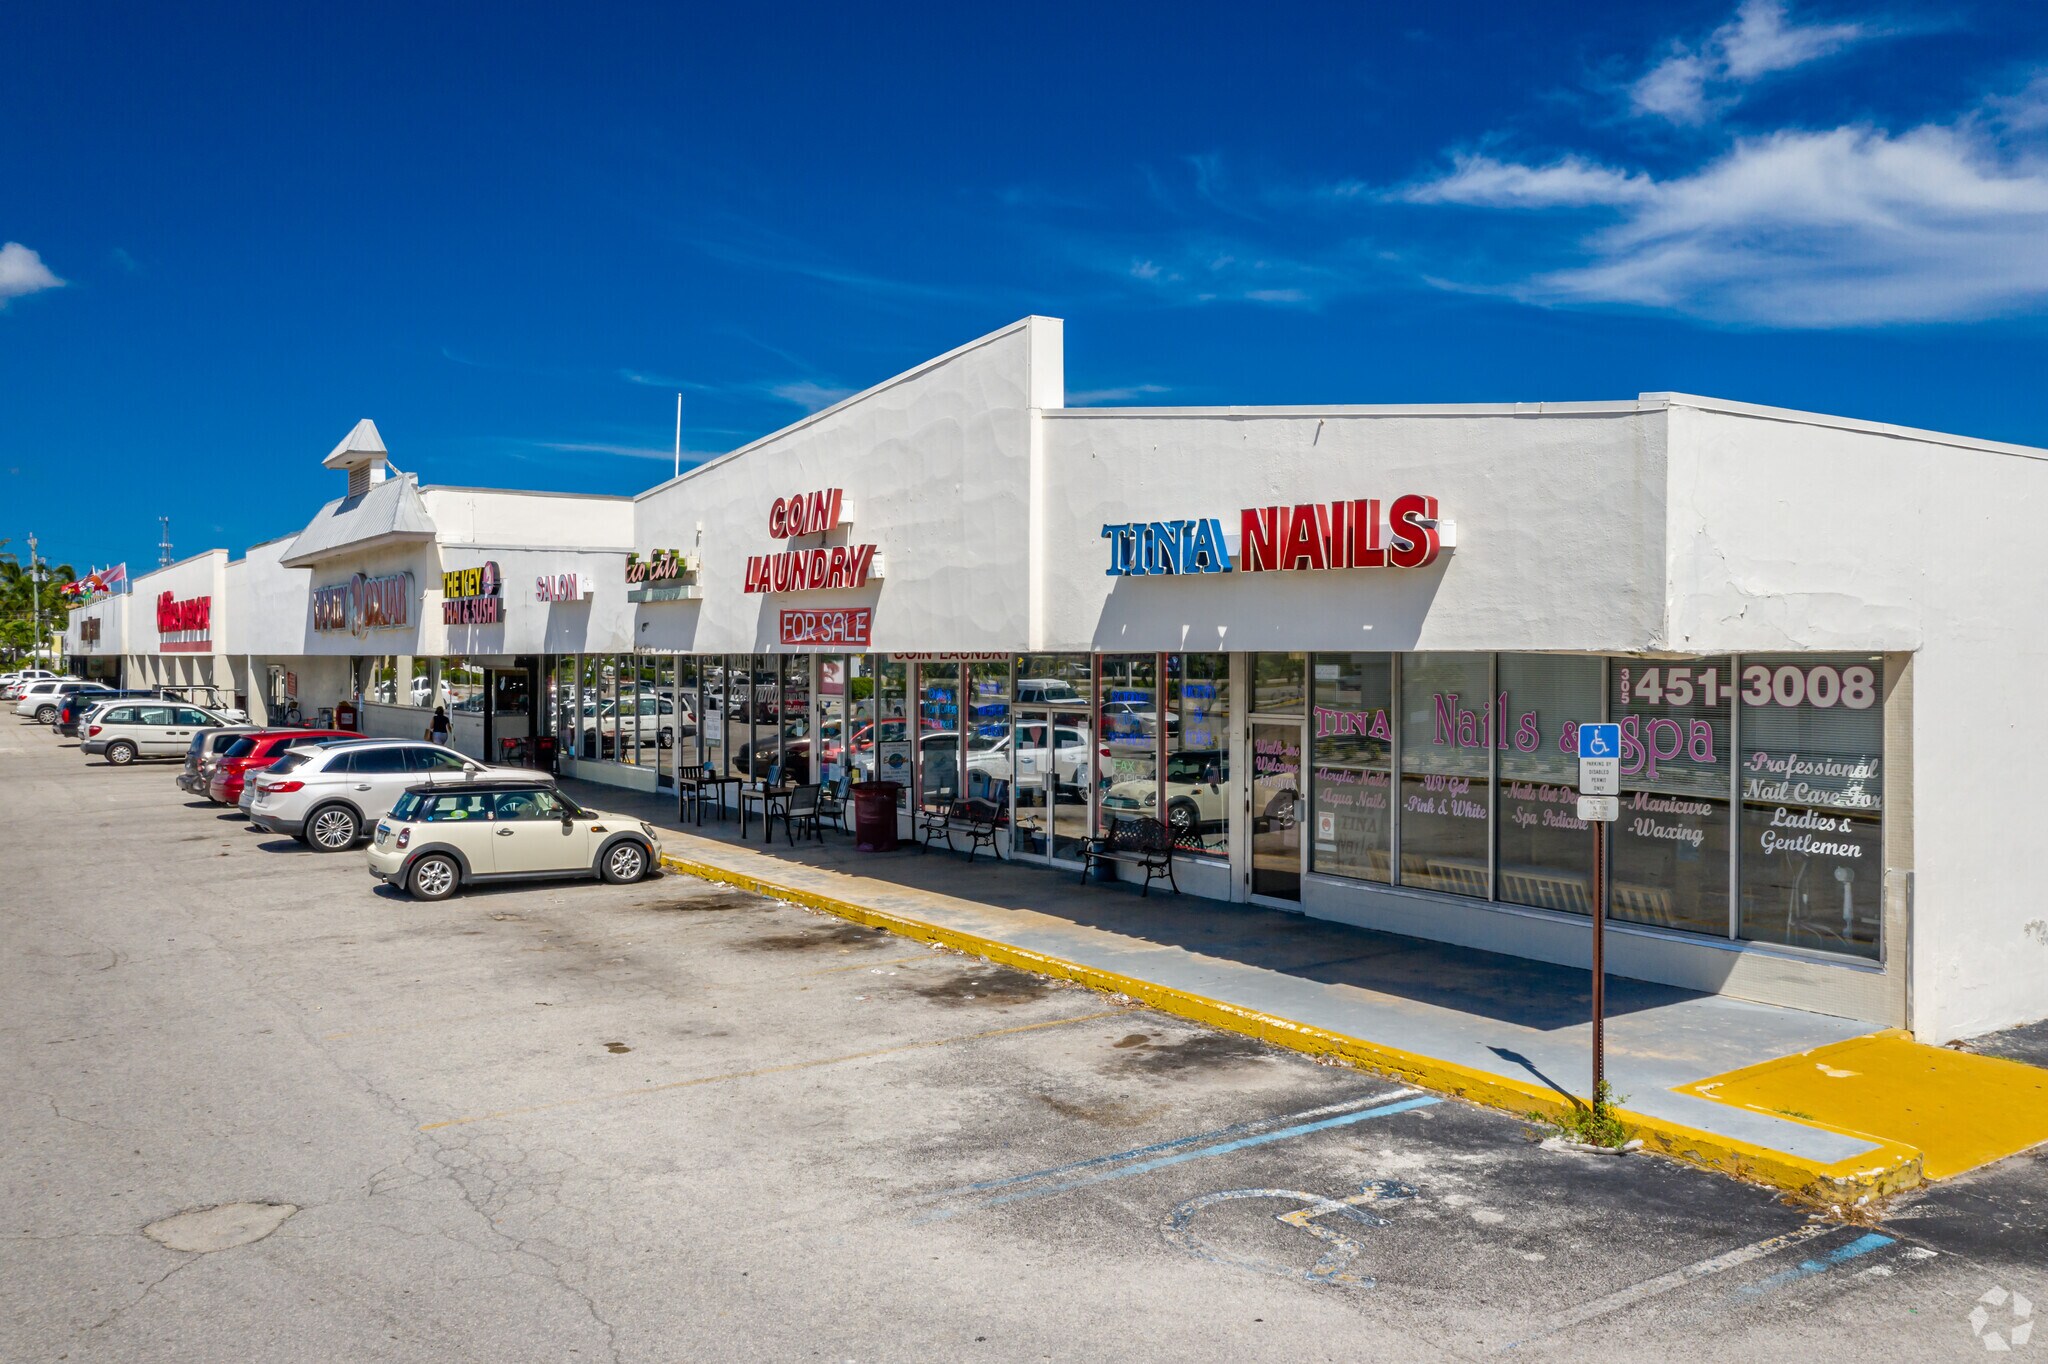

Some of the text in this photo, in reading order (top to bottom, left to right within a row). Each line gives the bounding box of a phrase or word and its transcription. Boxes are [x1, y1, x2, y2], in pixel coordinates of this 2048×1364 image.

[768, 487, 843, 539] COIN
[1100, 494, 1439, 577] TINA NAILS
[442, 566, 484, 598] THE KEY
[743, 543, 878, 594] LAUNDRY
[535, 572, 580, 603] SALON
[442, 597, 497, 625] THAI & SUSHI
[783, 611, 868, 642] FOR SALE
[894, 652, 1010, 660] COIN LAUNDRY
[1635, 664, 1876, 710] 451-3008
[1313, 705, 1392, 742] TINA
[1433, 691, 1540, 753] Nails
[1255, 738, 1300, 757] Walk-ins
[1114, 758, 1135, 773] FAX
[1255, 755, 1300, 775] Welcome
[1358, 769, 1391, 788] Nails
[1356, 790, 1387, 809] Nails
[1448, 776, 1470, 795] Gel
[1539, 783, 1558, 803] Art
[1743, 779, 1883, 809] Nail Care For
[1403, 795, 1488, 820] -Pink & White
[1542, 808, 1589, 831] Pedicure
[1770, 807, 1852, 833] Ladies &
[1760, 830, 1862, 858] Gentlemen
